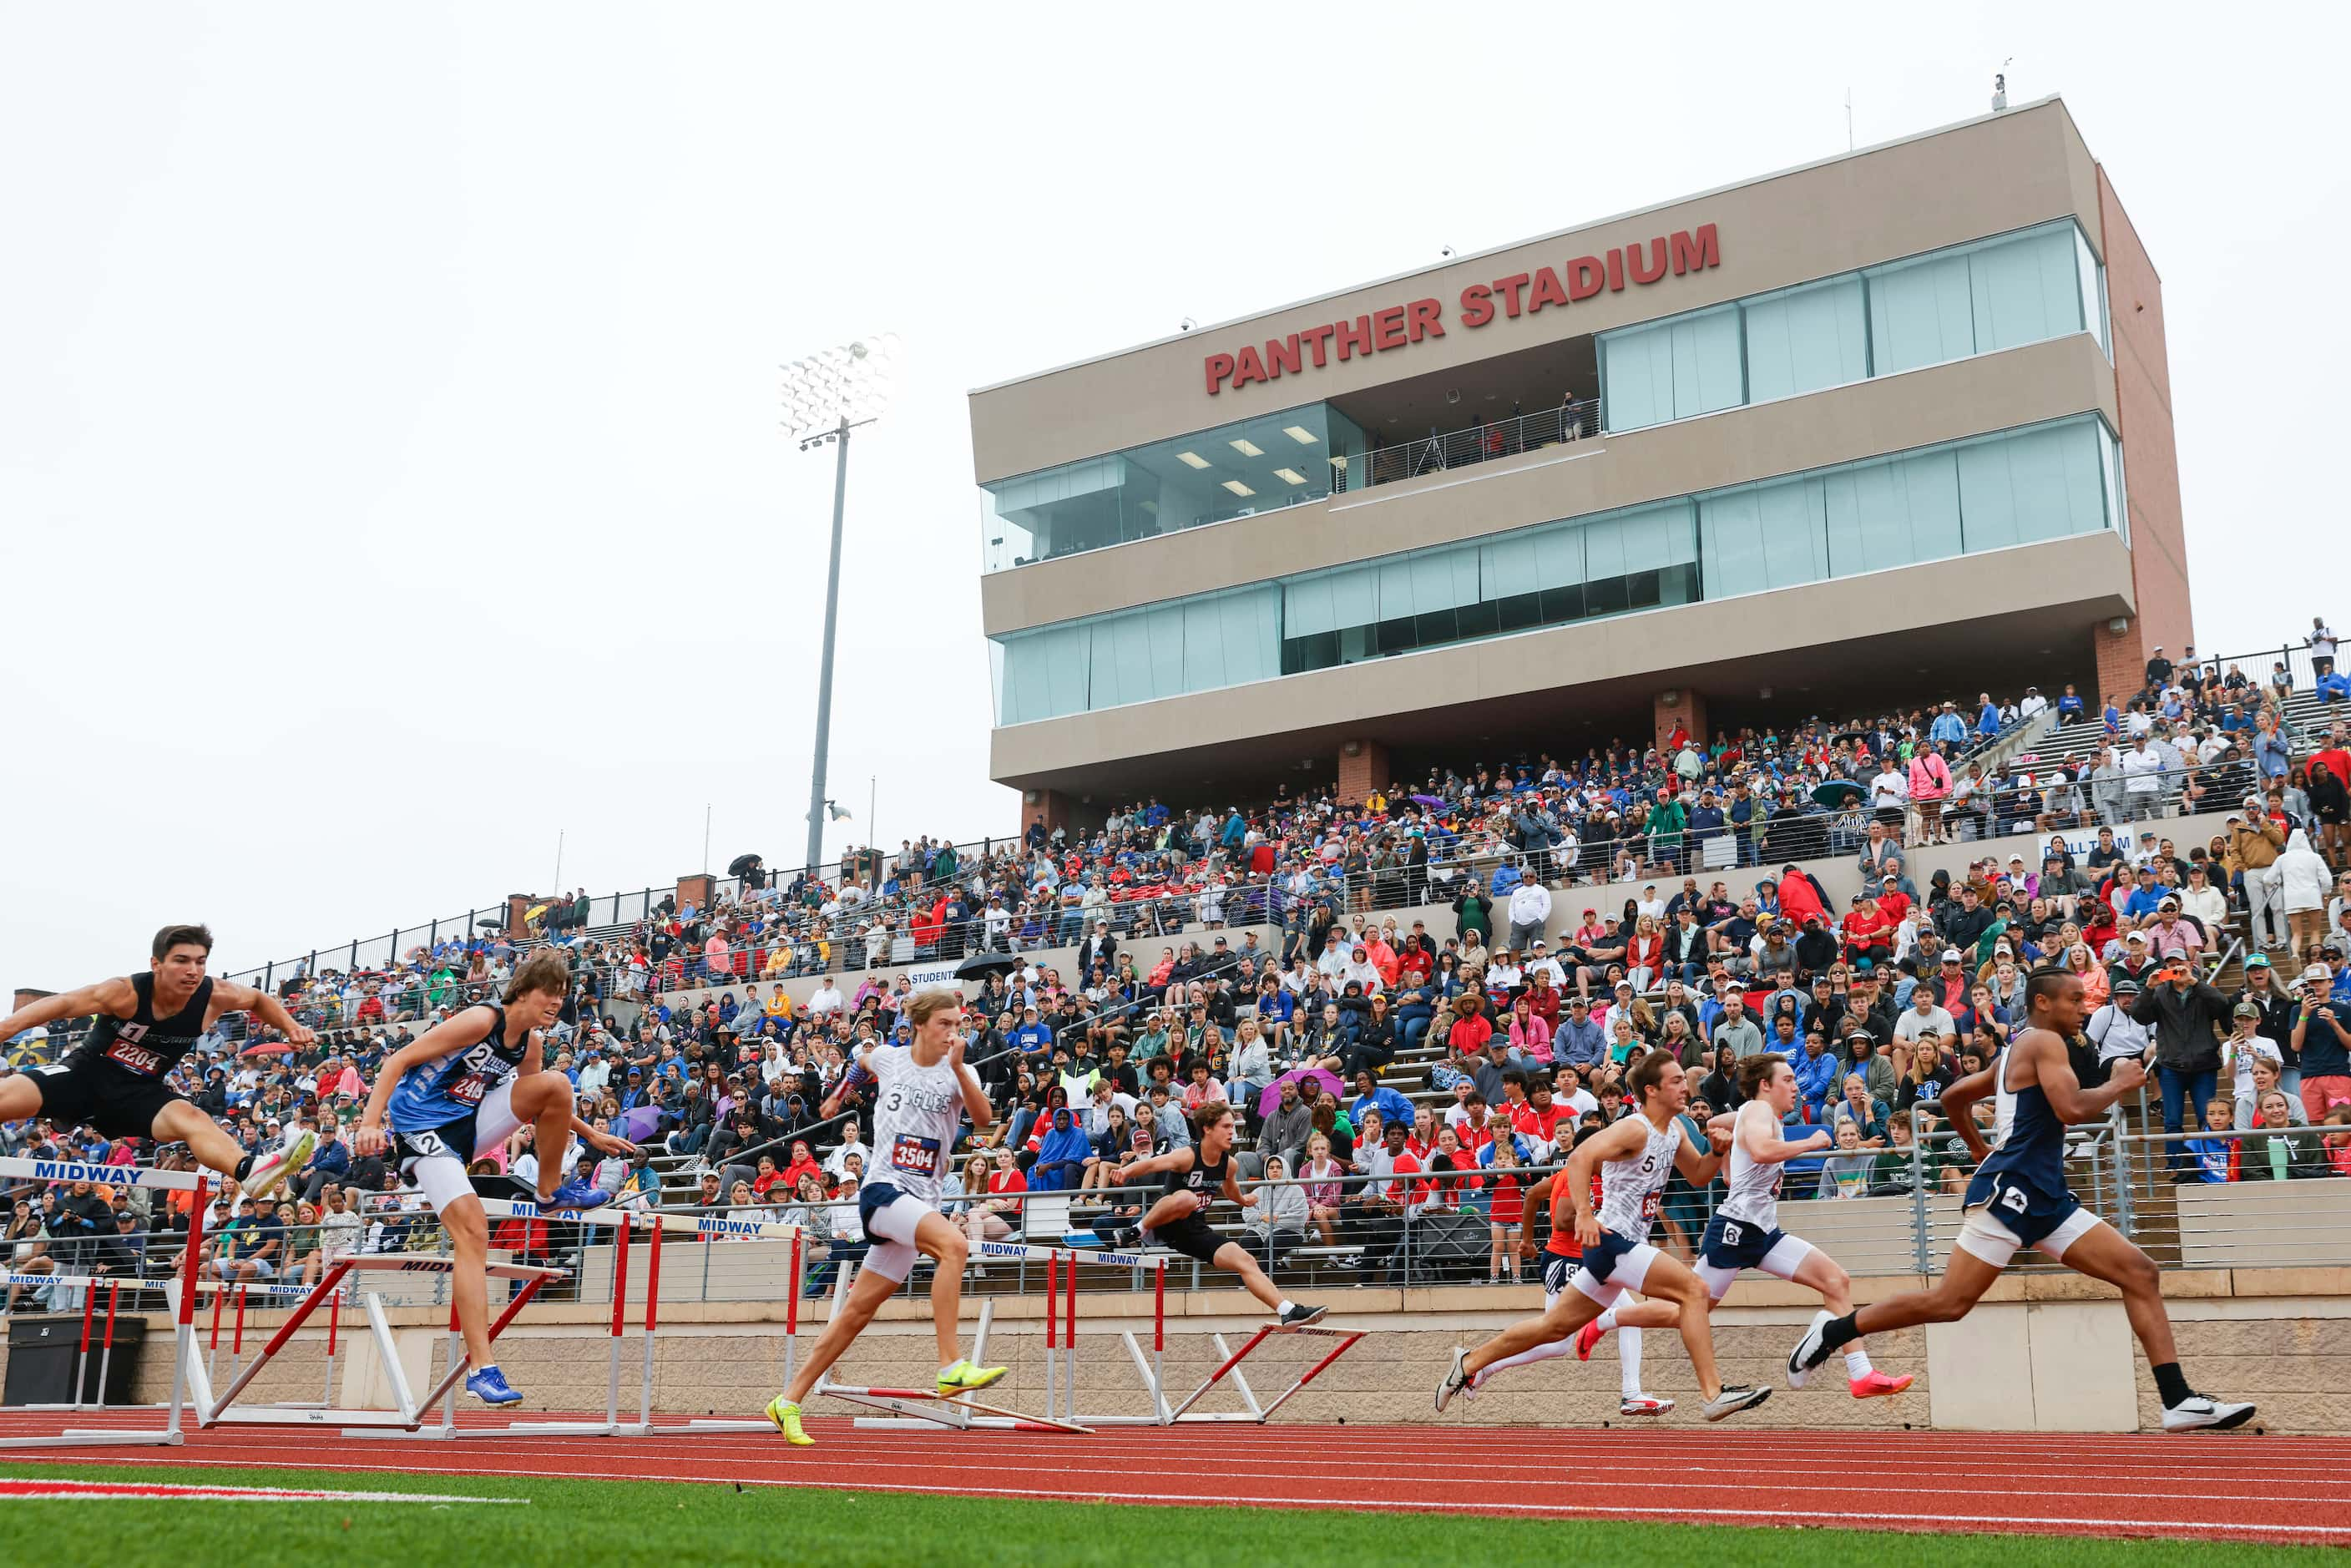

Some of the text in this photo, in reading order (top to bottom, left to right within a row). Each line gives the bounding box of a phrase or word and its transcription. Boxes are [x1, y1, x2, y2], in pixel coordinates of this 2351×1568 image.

[1205, 223, 1720, 395] PANTHER STADIUM
[2044, 837, 2130, 857] DILL TAM
[113, 1043, 160, 1070] 2204
[468, 1048, 488, 1068] 2
[887, 1093, 902, 1112] 3
[421, 1135, 442, 1155] 2
[896, 1146, 935, 1168] 3504
[1641, 1155, 1656, 1173] 5
[35, 1162, 144, 1184] MIDWAY
[1191, 1174, 1201, 1186] 7
[698, 1219, 762, 1235] MIDWAY
[1726, 1227, 1737, 1243] 6
[981, 1242, 1029, 1257] MIDWAY
[1098, 1253, 1140, 1266] MIDWAY
[9, 1275, 63, 1285] MIDWAY
[1568, 1266, 1578, 1279] 8
[269, 1286, 314, 1295] MIDWAY
